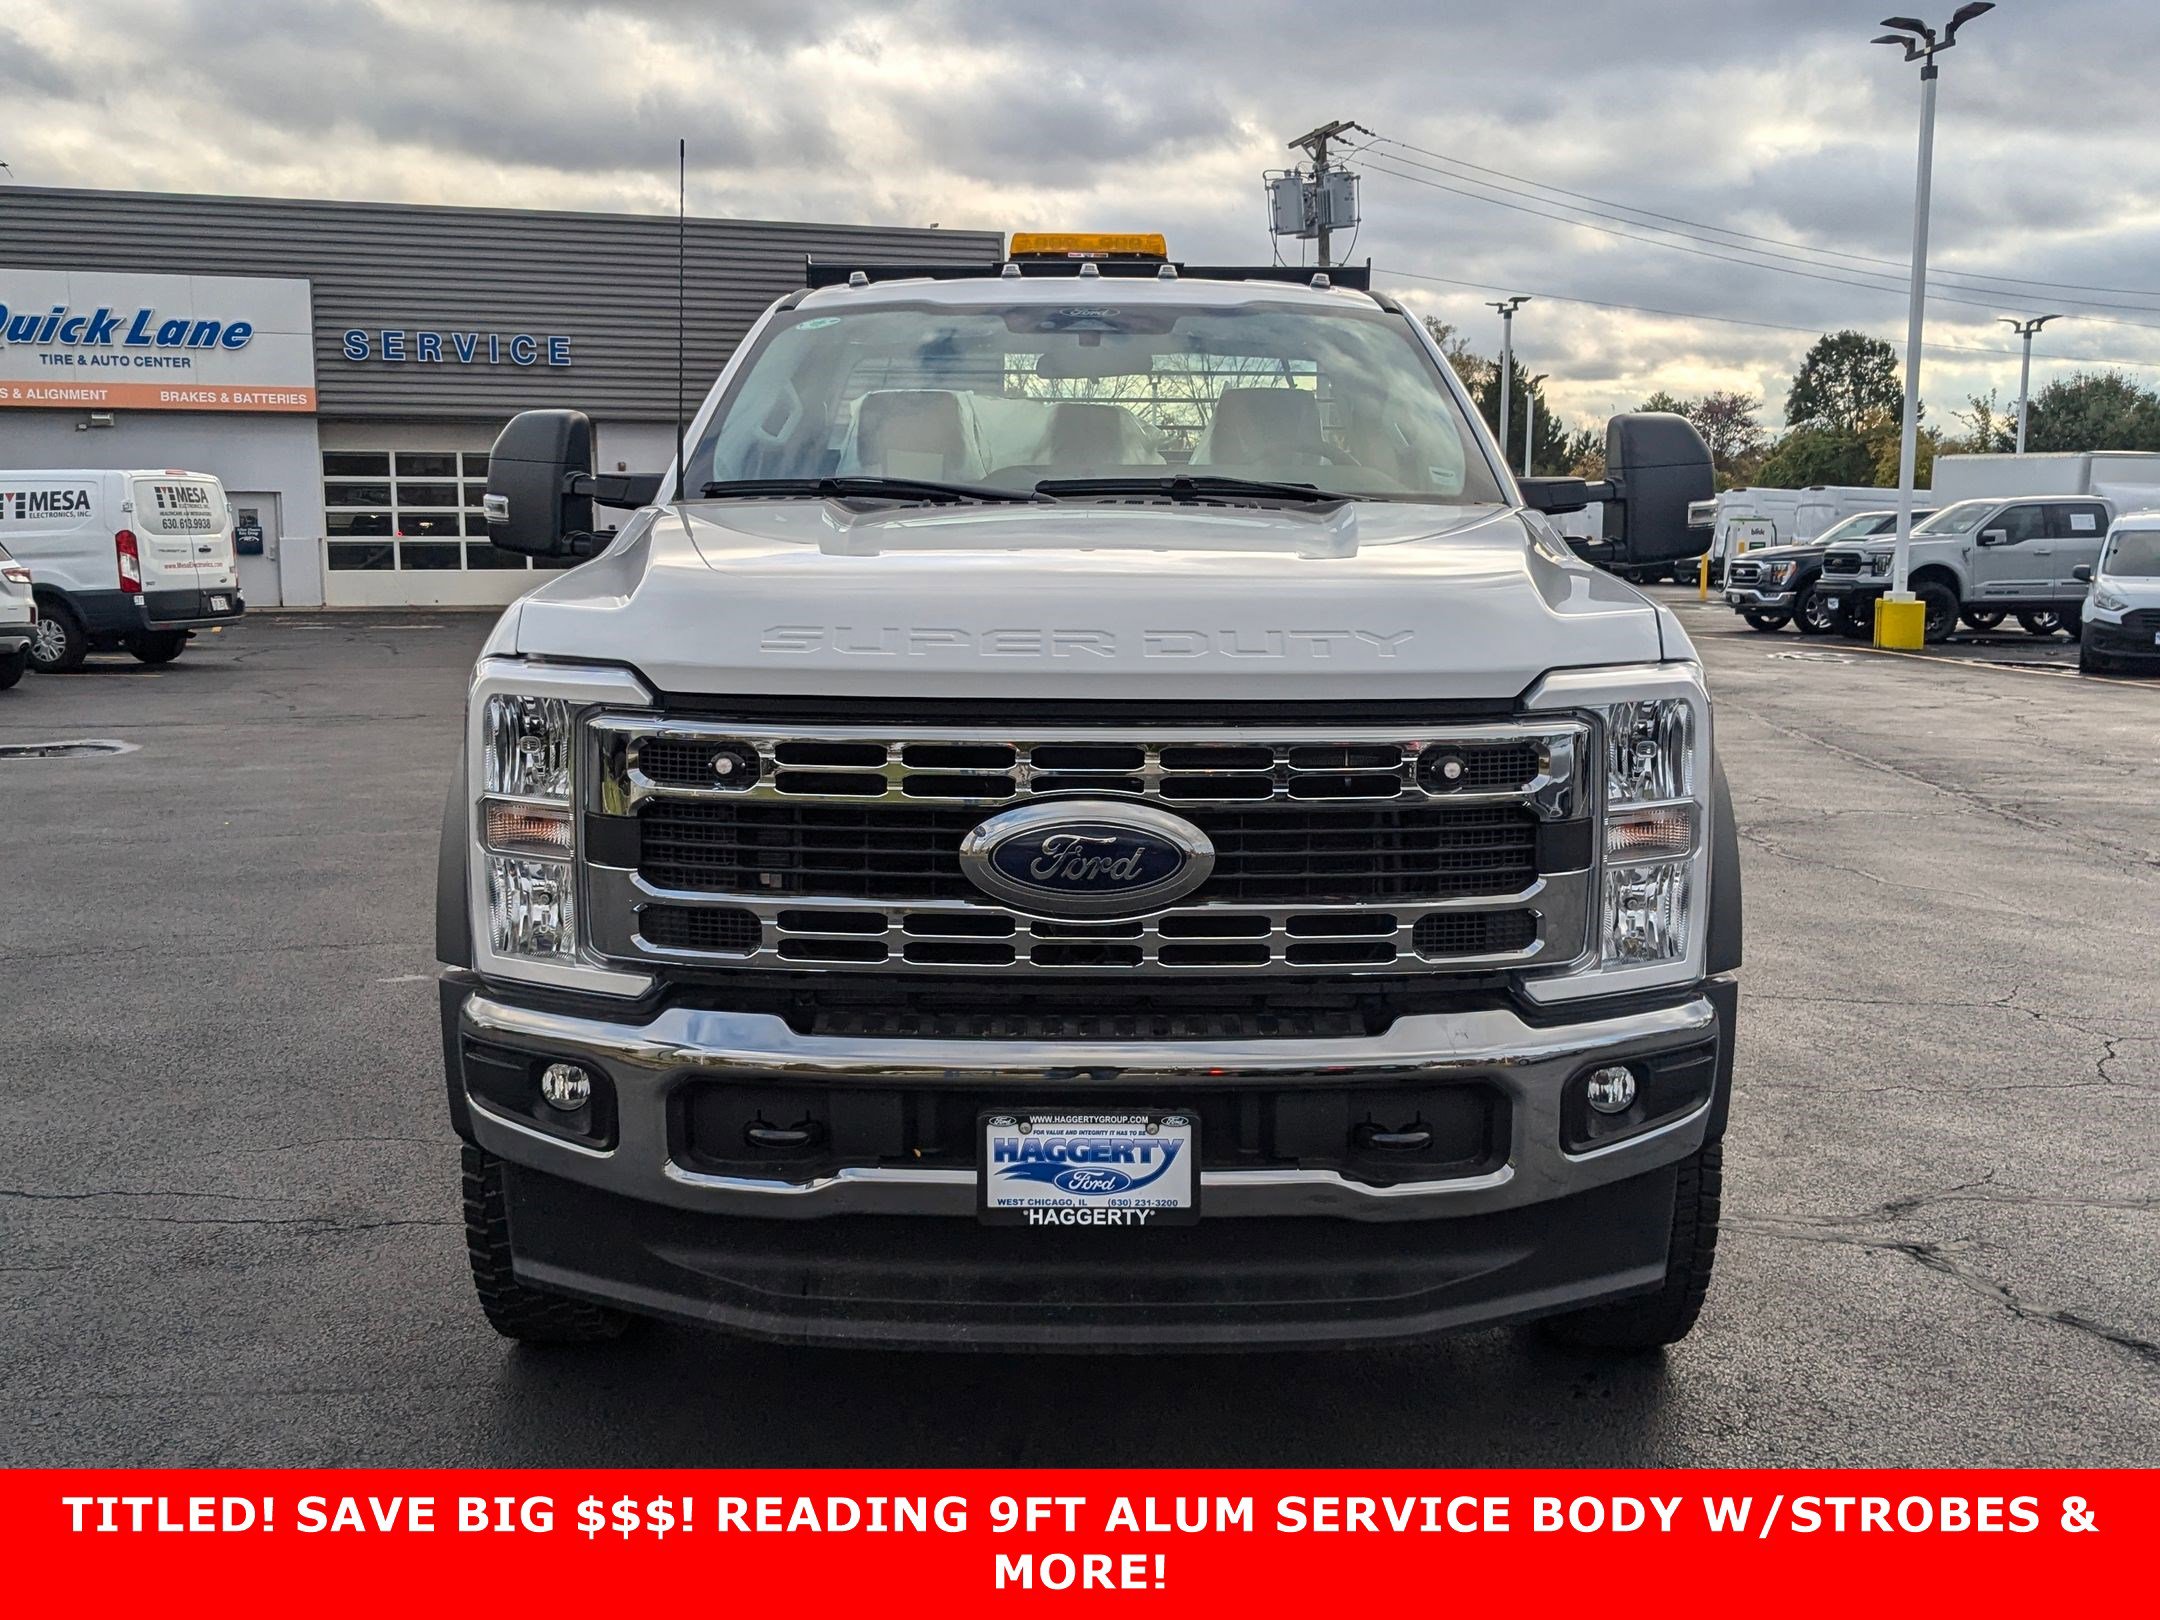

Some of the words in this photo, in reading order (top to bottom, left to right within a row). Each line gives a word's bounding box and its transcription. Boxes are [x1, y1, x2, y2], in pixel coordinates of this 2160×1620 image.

[123, 306, 254, 350] Lane
[343, 329, 572, 366] SERVICE
[39, 353, 73, 366] TIRE
[77, 355, 87, 366] &
[91, 355, 130, 367] AUTO
[133, 356, 191, 369] CENTER
[12, 388, 22, 399] &
[26, 388, 108, 401] ALIGNMENT
[160, 391, 217, 404] BRAKES
[220, 393, 230, 404] &
[233, 393, 308, 406] BATTERIES
[29, 490, 91, 511] MESA
[174, 486, 209, 503] MESA
[29, 511, 76, 519] ELECTRONICS,
[77, 510, 92, 518] INC.
[162, 518, 211, 529] 630.613.9938
[760, 626, 1116, 658] SUPER
[1143, 629, 1414, 658] DUTY
[1030, 834, 1145, 880] Ford
[1029, 1115, 1149, 1124] WWW.HAGGERTYGROUP.COM
[993, 1138, 1185, 1164] HAGGERTY
[1068, 1171, 1116, 1191] Ford
[997, 1198, 1025, 1206] WEST
[1027, 1198, 1076, 1207] CHICAGO,
[1078, 1198, 1088, 1206] IL
[1107, 1199, 1132, 1207] (630)
[1134, 1199, 1179, 1207] 231-3200
